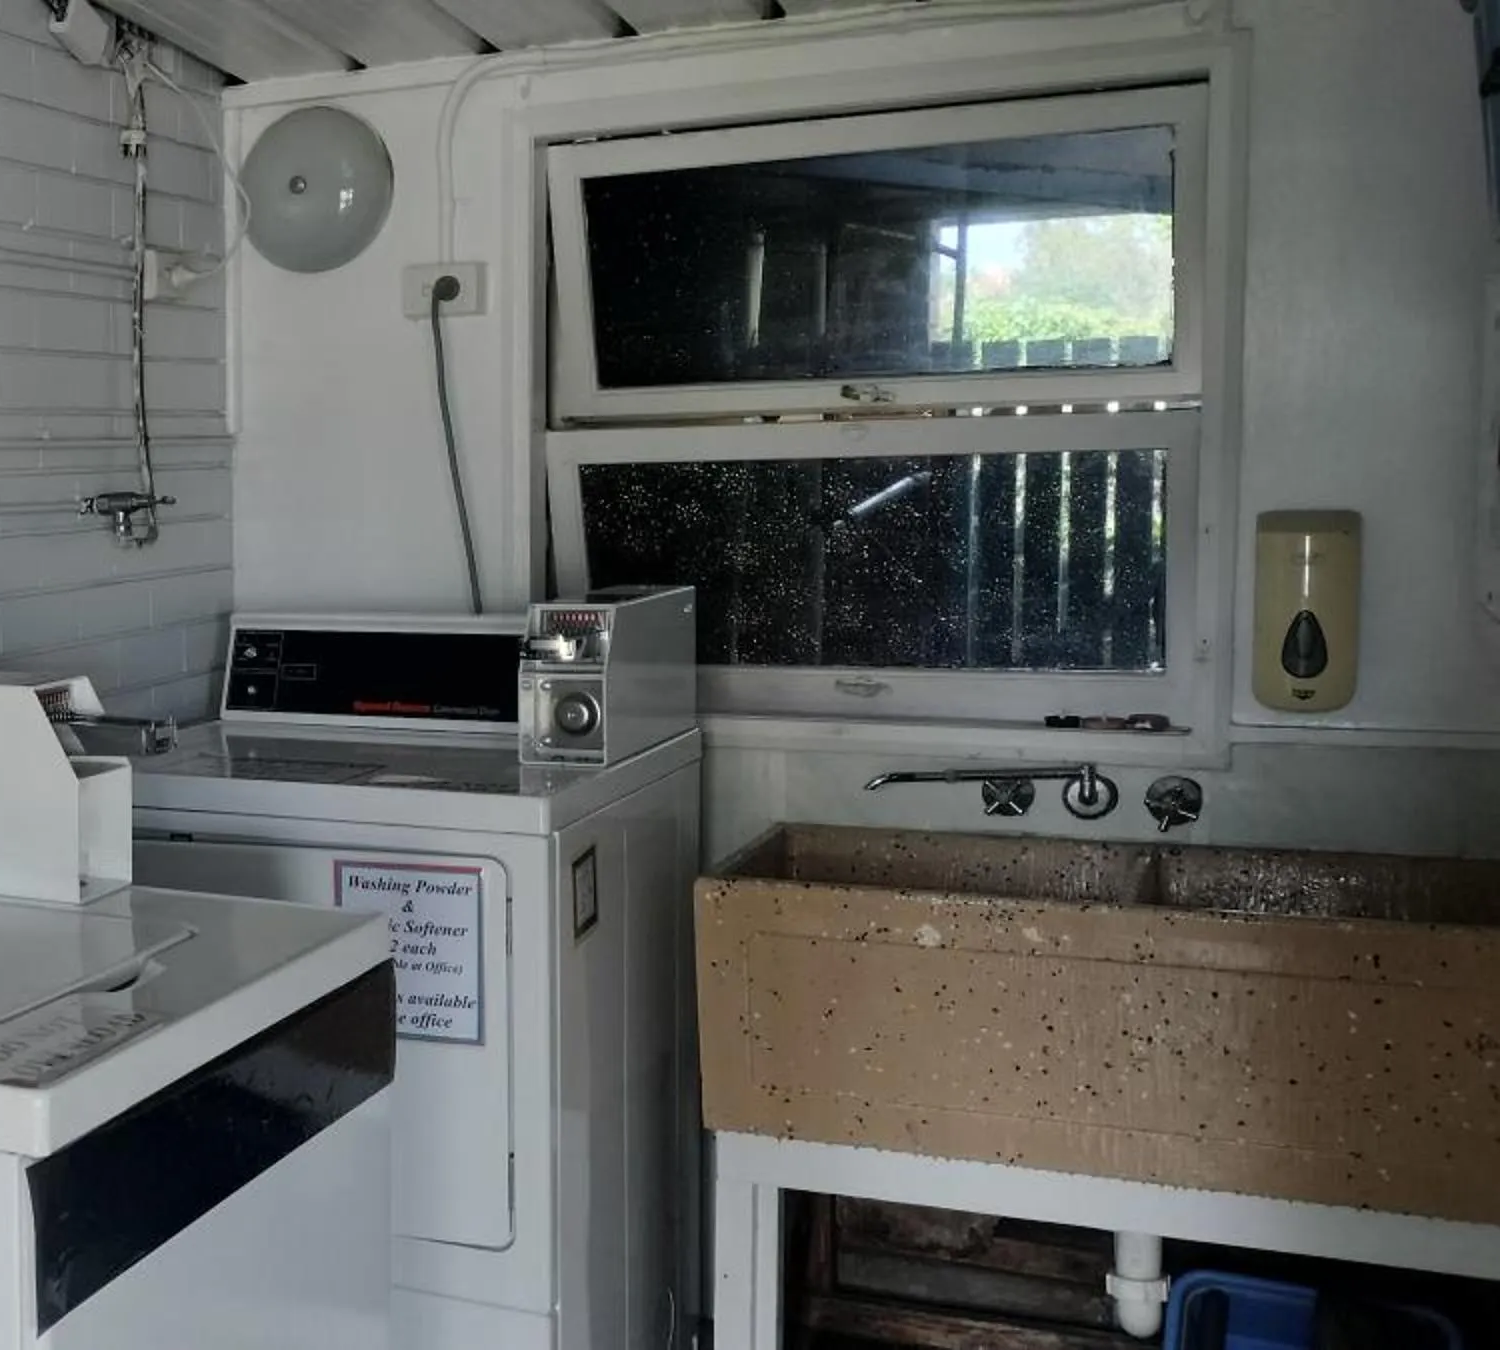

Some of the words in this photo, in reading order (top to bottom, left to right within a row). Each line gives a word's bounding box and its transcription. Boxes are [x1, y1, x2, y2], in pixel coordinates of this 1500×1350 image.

[348, 875, 411, 895] Washing
[415, 880, 472, 896] Powder
[402, 900, 414, 913] &
[403, 920, 468, 937] Softener
[402, 941, 437, 956] each
[407, 992, 477, 1009] available
[411, 1013, 453, 1029] office
